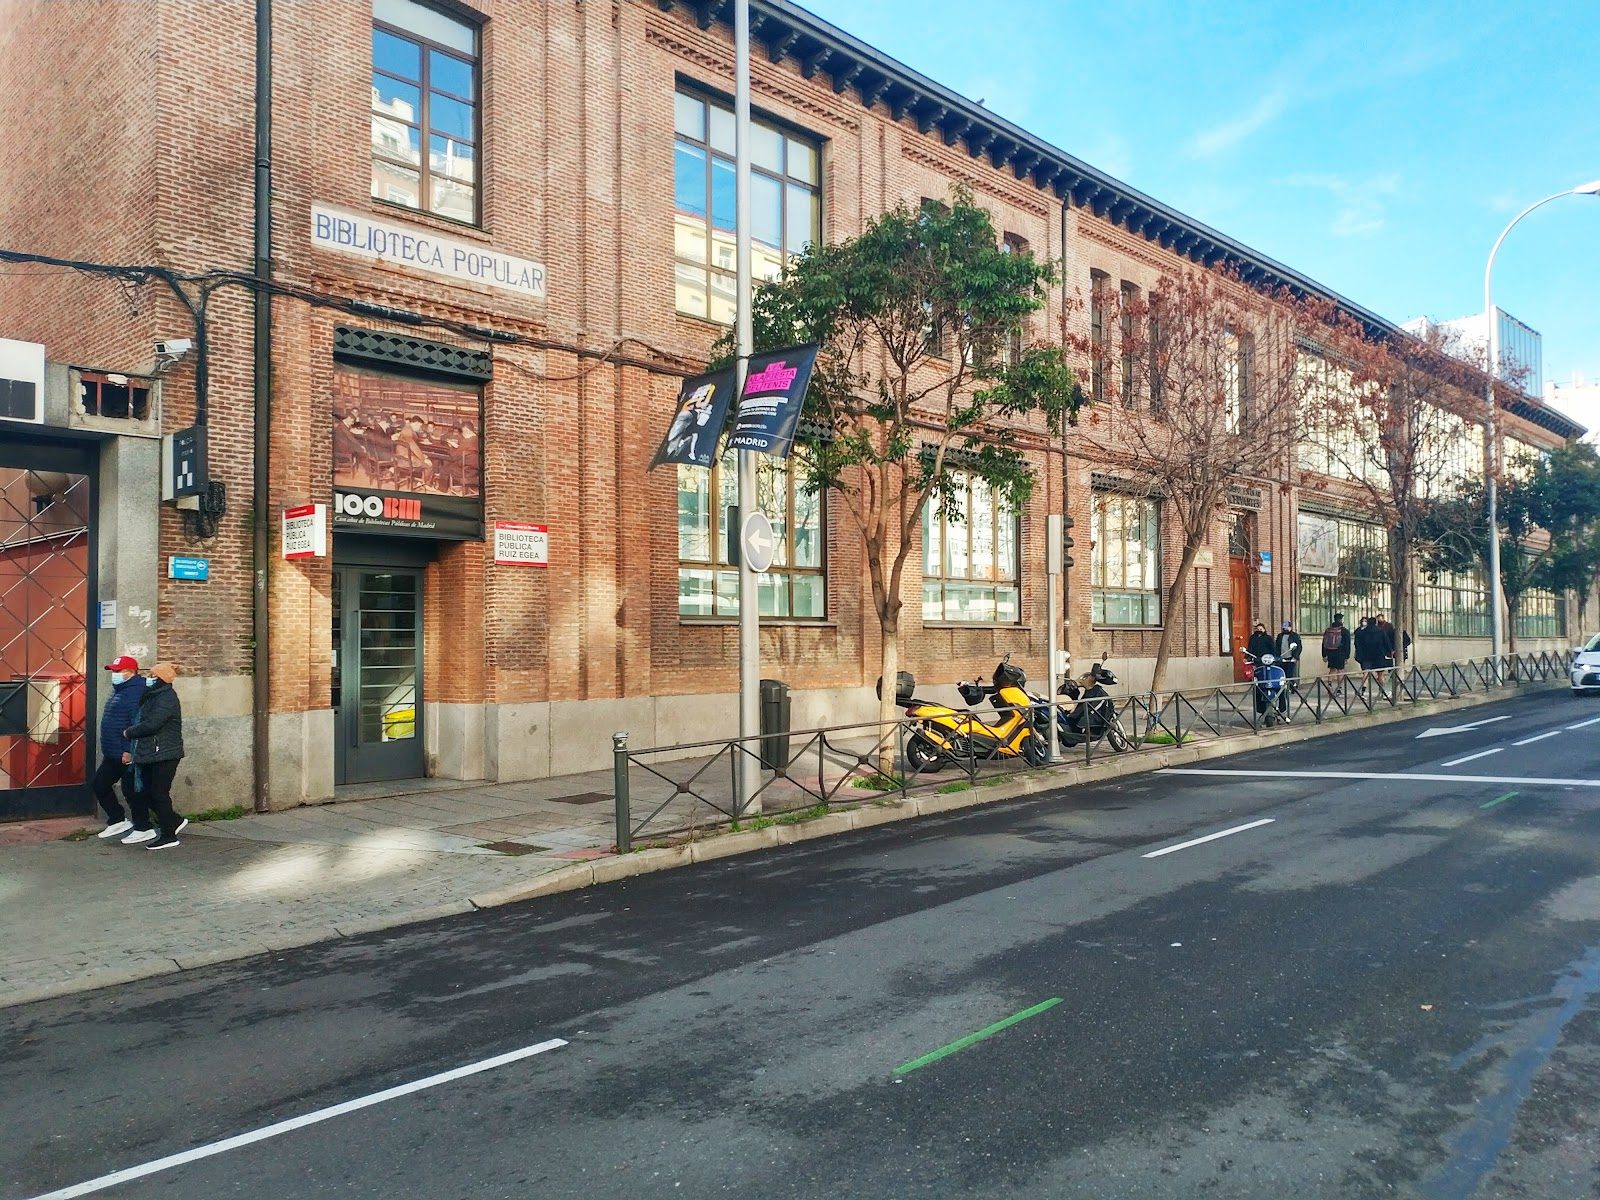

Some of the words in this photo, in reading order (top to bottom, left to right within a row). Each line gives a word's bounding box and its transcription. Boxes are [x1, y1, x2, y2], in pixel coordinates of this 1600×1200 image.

[315, 212, 445, 269] BIBLIOTECA
[454, 247, 544, 292] POPULAR
[734, 437, 768, 448] MADRID
[499, 533, 544, 543] BIBLIOTECA
[499, 550, 517, 558] RUIZ
[519, 551, 539, 559] EGEA
